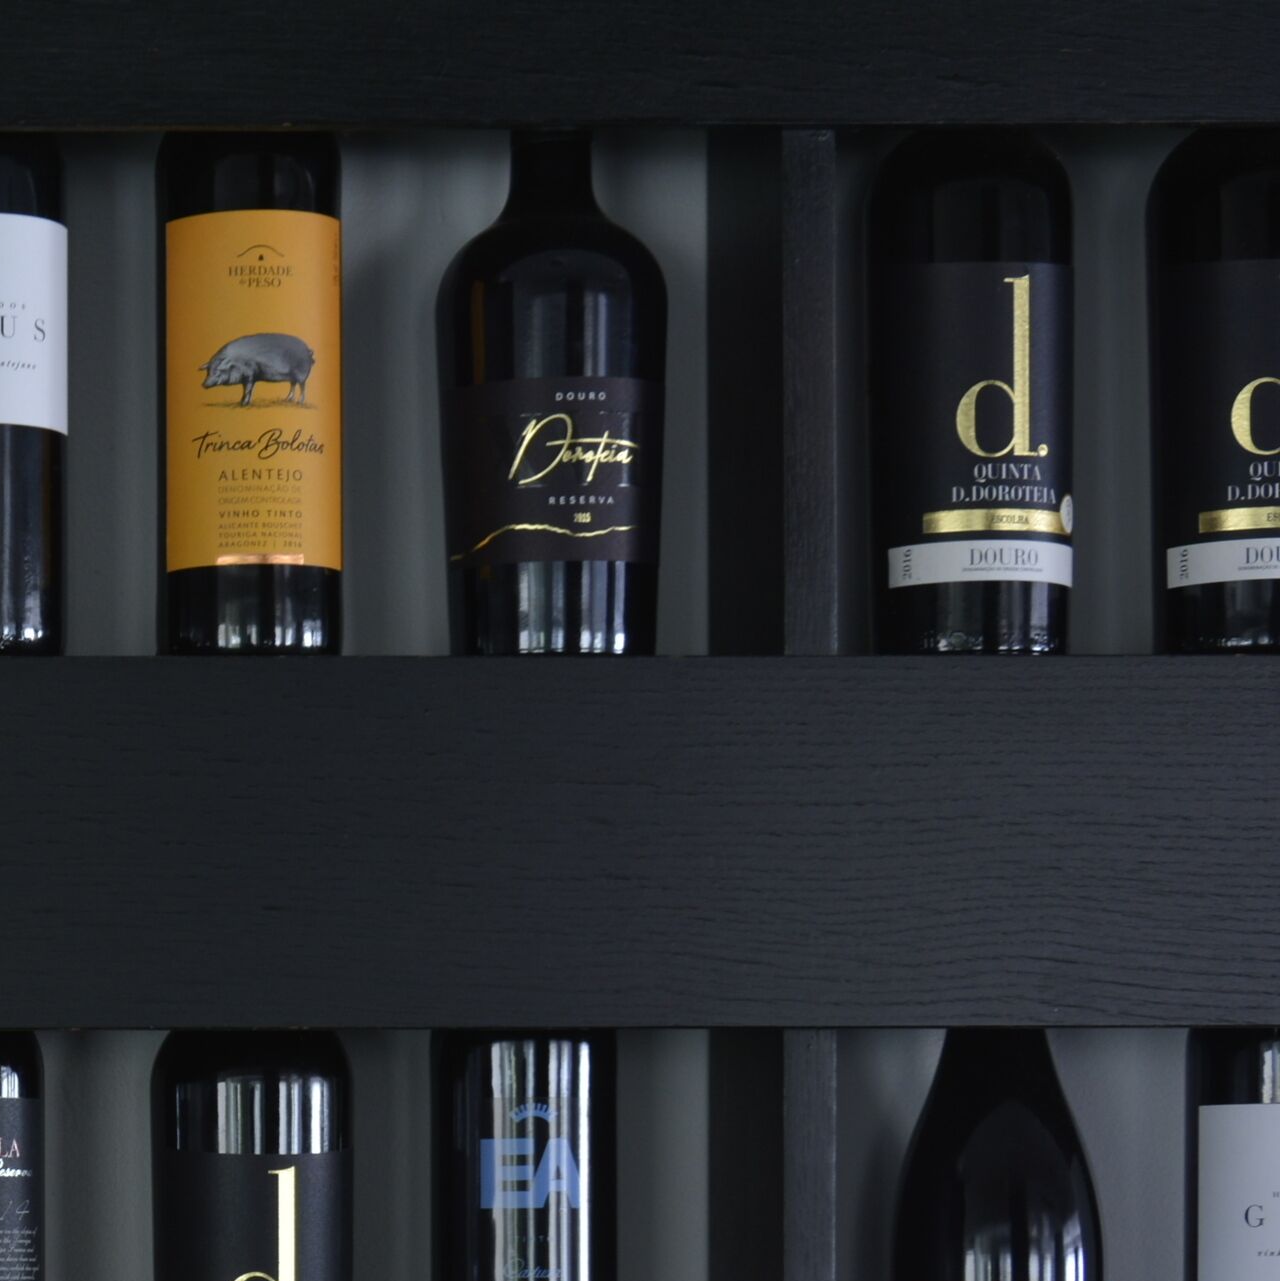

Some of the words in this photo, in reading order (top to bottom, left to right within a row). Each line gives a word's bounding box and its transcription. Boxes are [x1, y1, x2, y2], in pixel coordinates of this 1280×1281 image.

[228, 265, 293, 277] HERDADE
[247, 277, 282, 289] PESO
[555, 391, 607, 402] DOURO
[191, 431, 258, 459] Trinca
[258, 428, 325, 460] Bolotas
[218, 468, 303, 482] ALENTEJO
[973, 462, 1042, 483] QUINTA
[548, 495, 615, 505] RESERVA
[951, 485, 1057, 505] D.DOROTEIA
[219, 509, 260, 519] VINHO
[266, 509, 303, 518] TINTO
[969, 546, 1038, 567] DOURO
